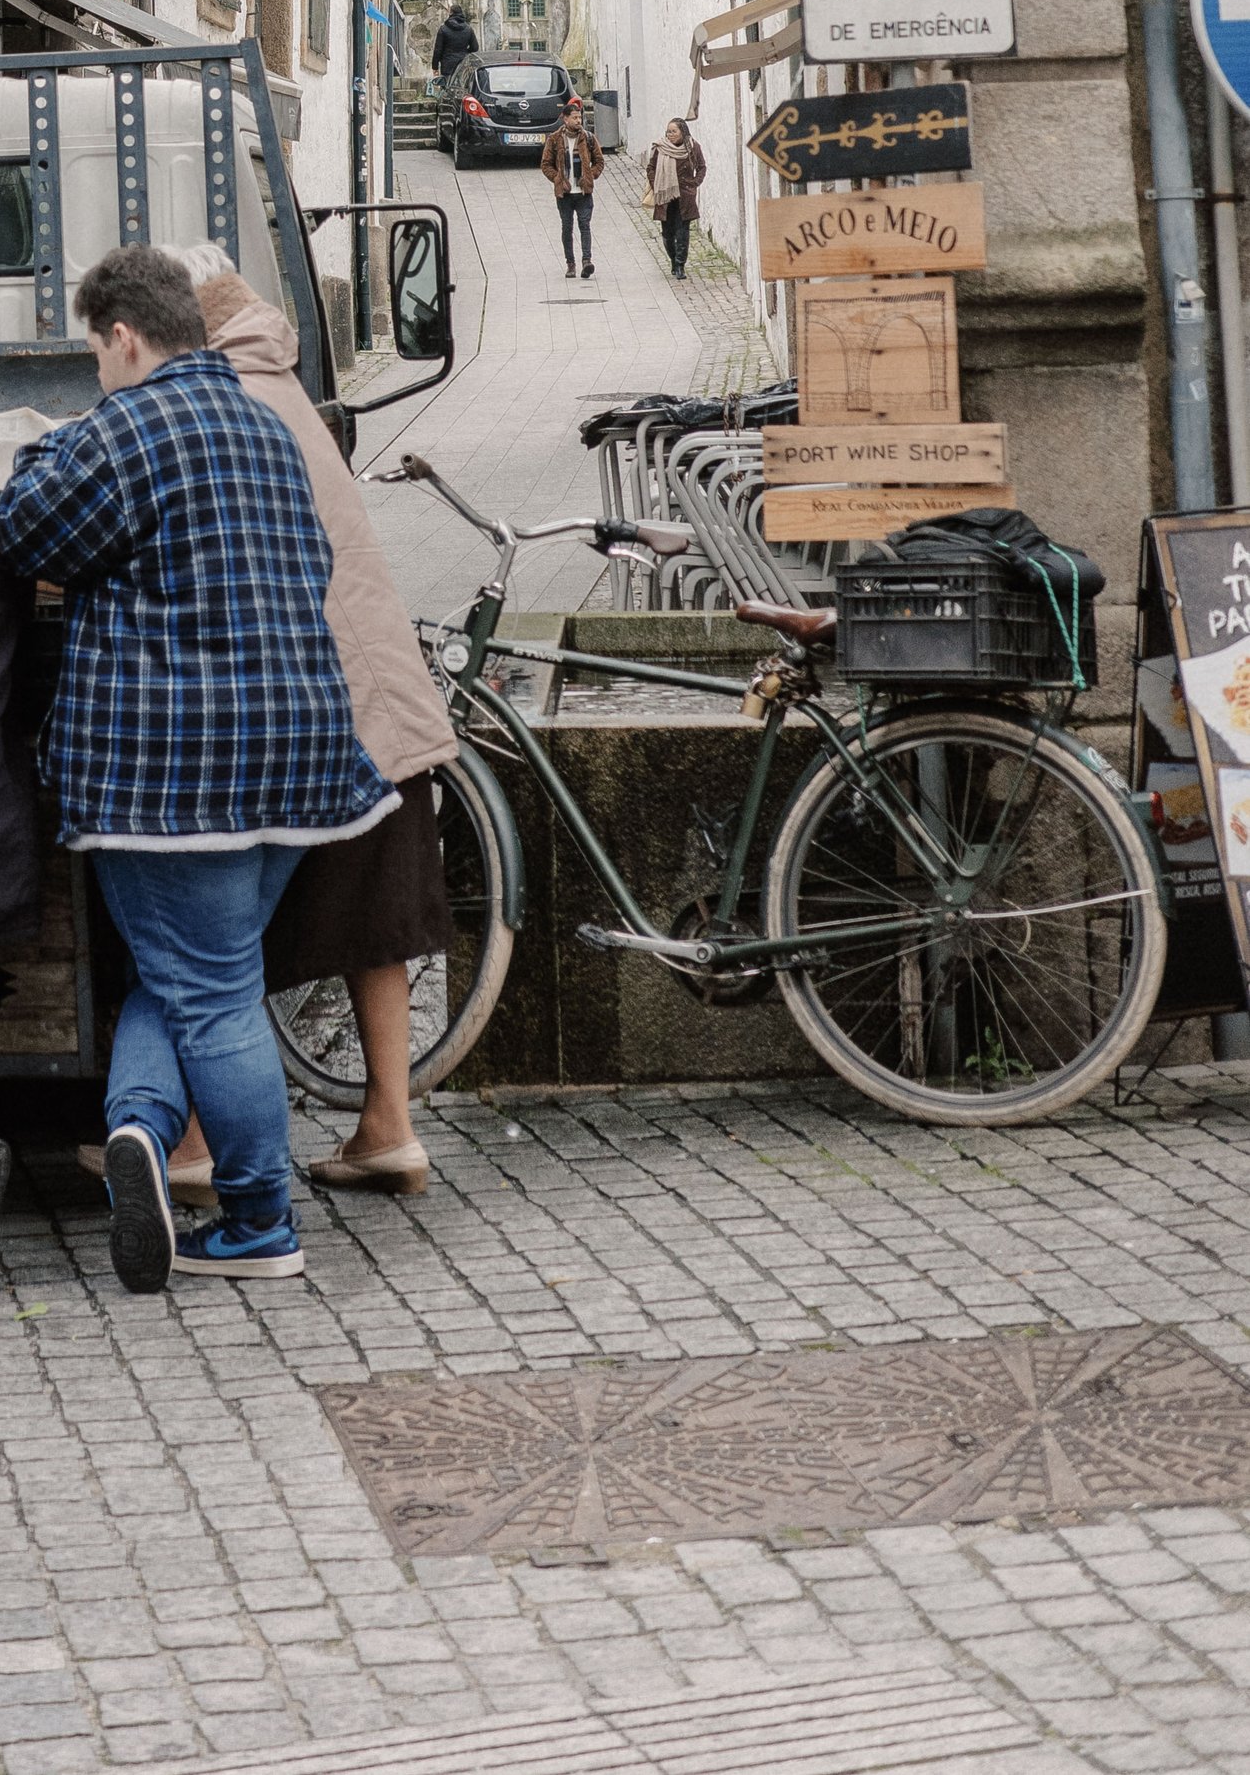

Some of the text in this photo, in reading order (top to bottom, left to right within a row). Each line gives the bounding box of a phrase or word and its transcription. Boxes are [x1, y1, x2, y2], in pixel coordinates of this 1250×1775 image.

[830, 12, 992, 41] DE EMERGÊNCIA
[783, 205, 958, 266] ARCO e MEIO
[784, 443, 970, 464] PORT WINE SHOP
